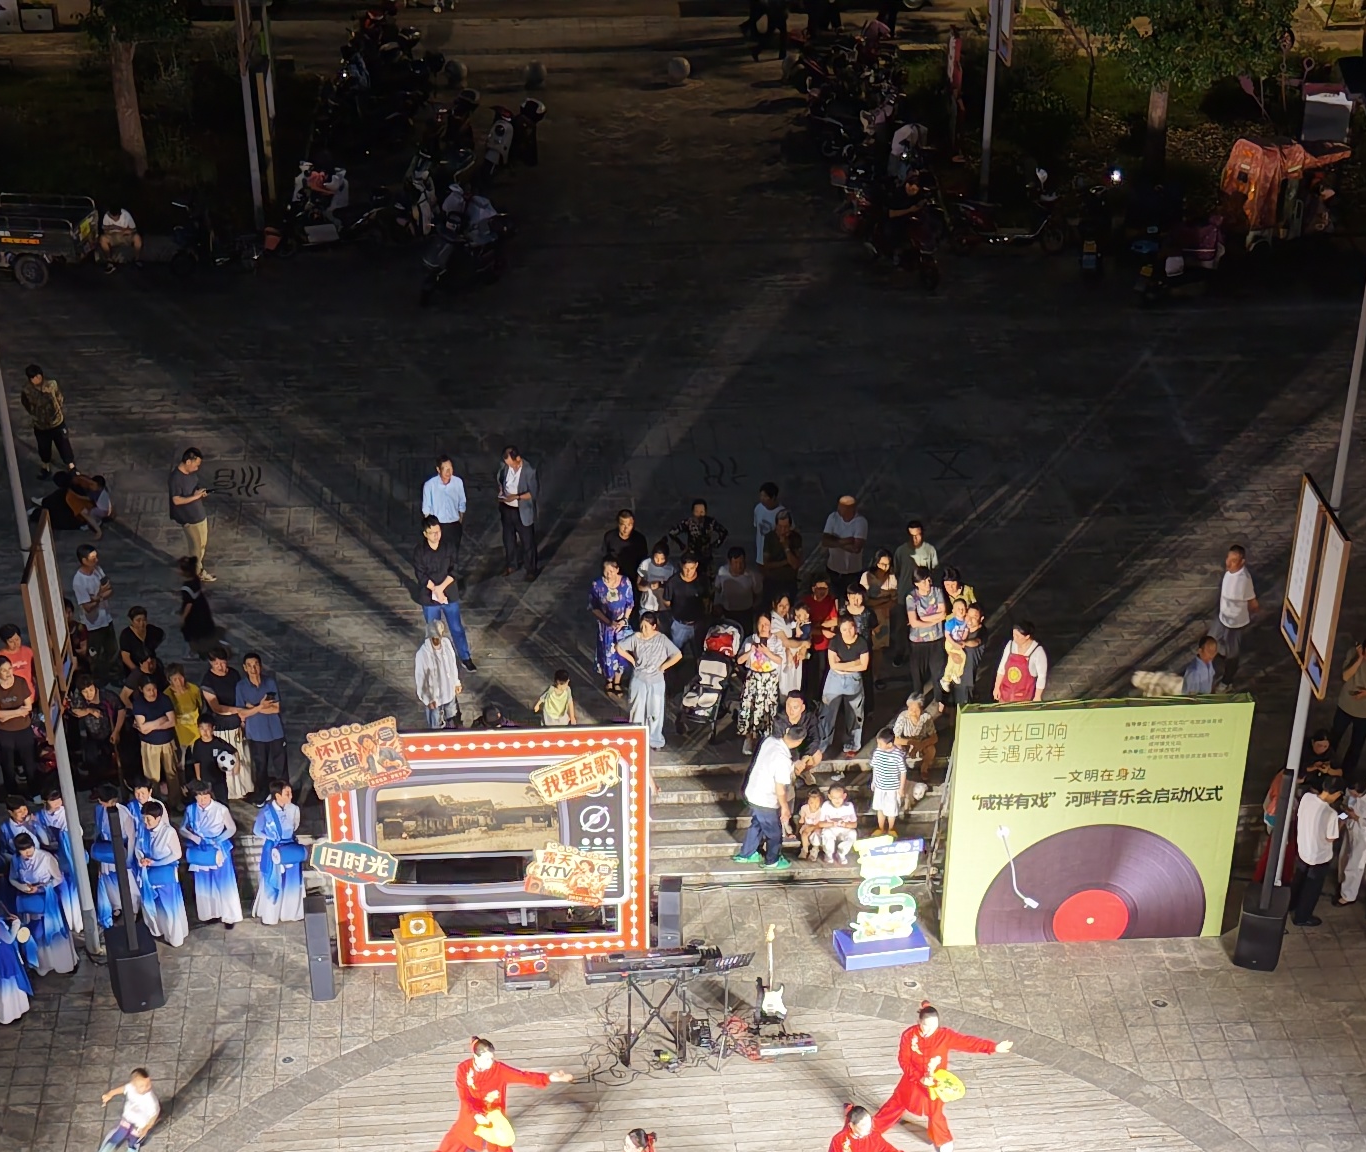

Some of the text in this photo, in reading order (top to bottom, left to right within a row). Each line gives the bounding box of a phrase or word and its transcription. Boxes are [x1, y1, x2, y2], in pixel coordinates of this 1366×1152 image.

[981, 721, 1068, 743] 时光回响
[315, 737, 352, 761] 怀旧
[978, 743, 1066, 764] 美遇咸祥
[319, 751, 360, 778] 金曲
[542, 754, 614, 798] 我要点歌
[319, 846, 390, 878] 旧时光
[542, 851, 573, 867] 露天
[540, 864, 573, 878] KTV
